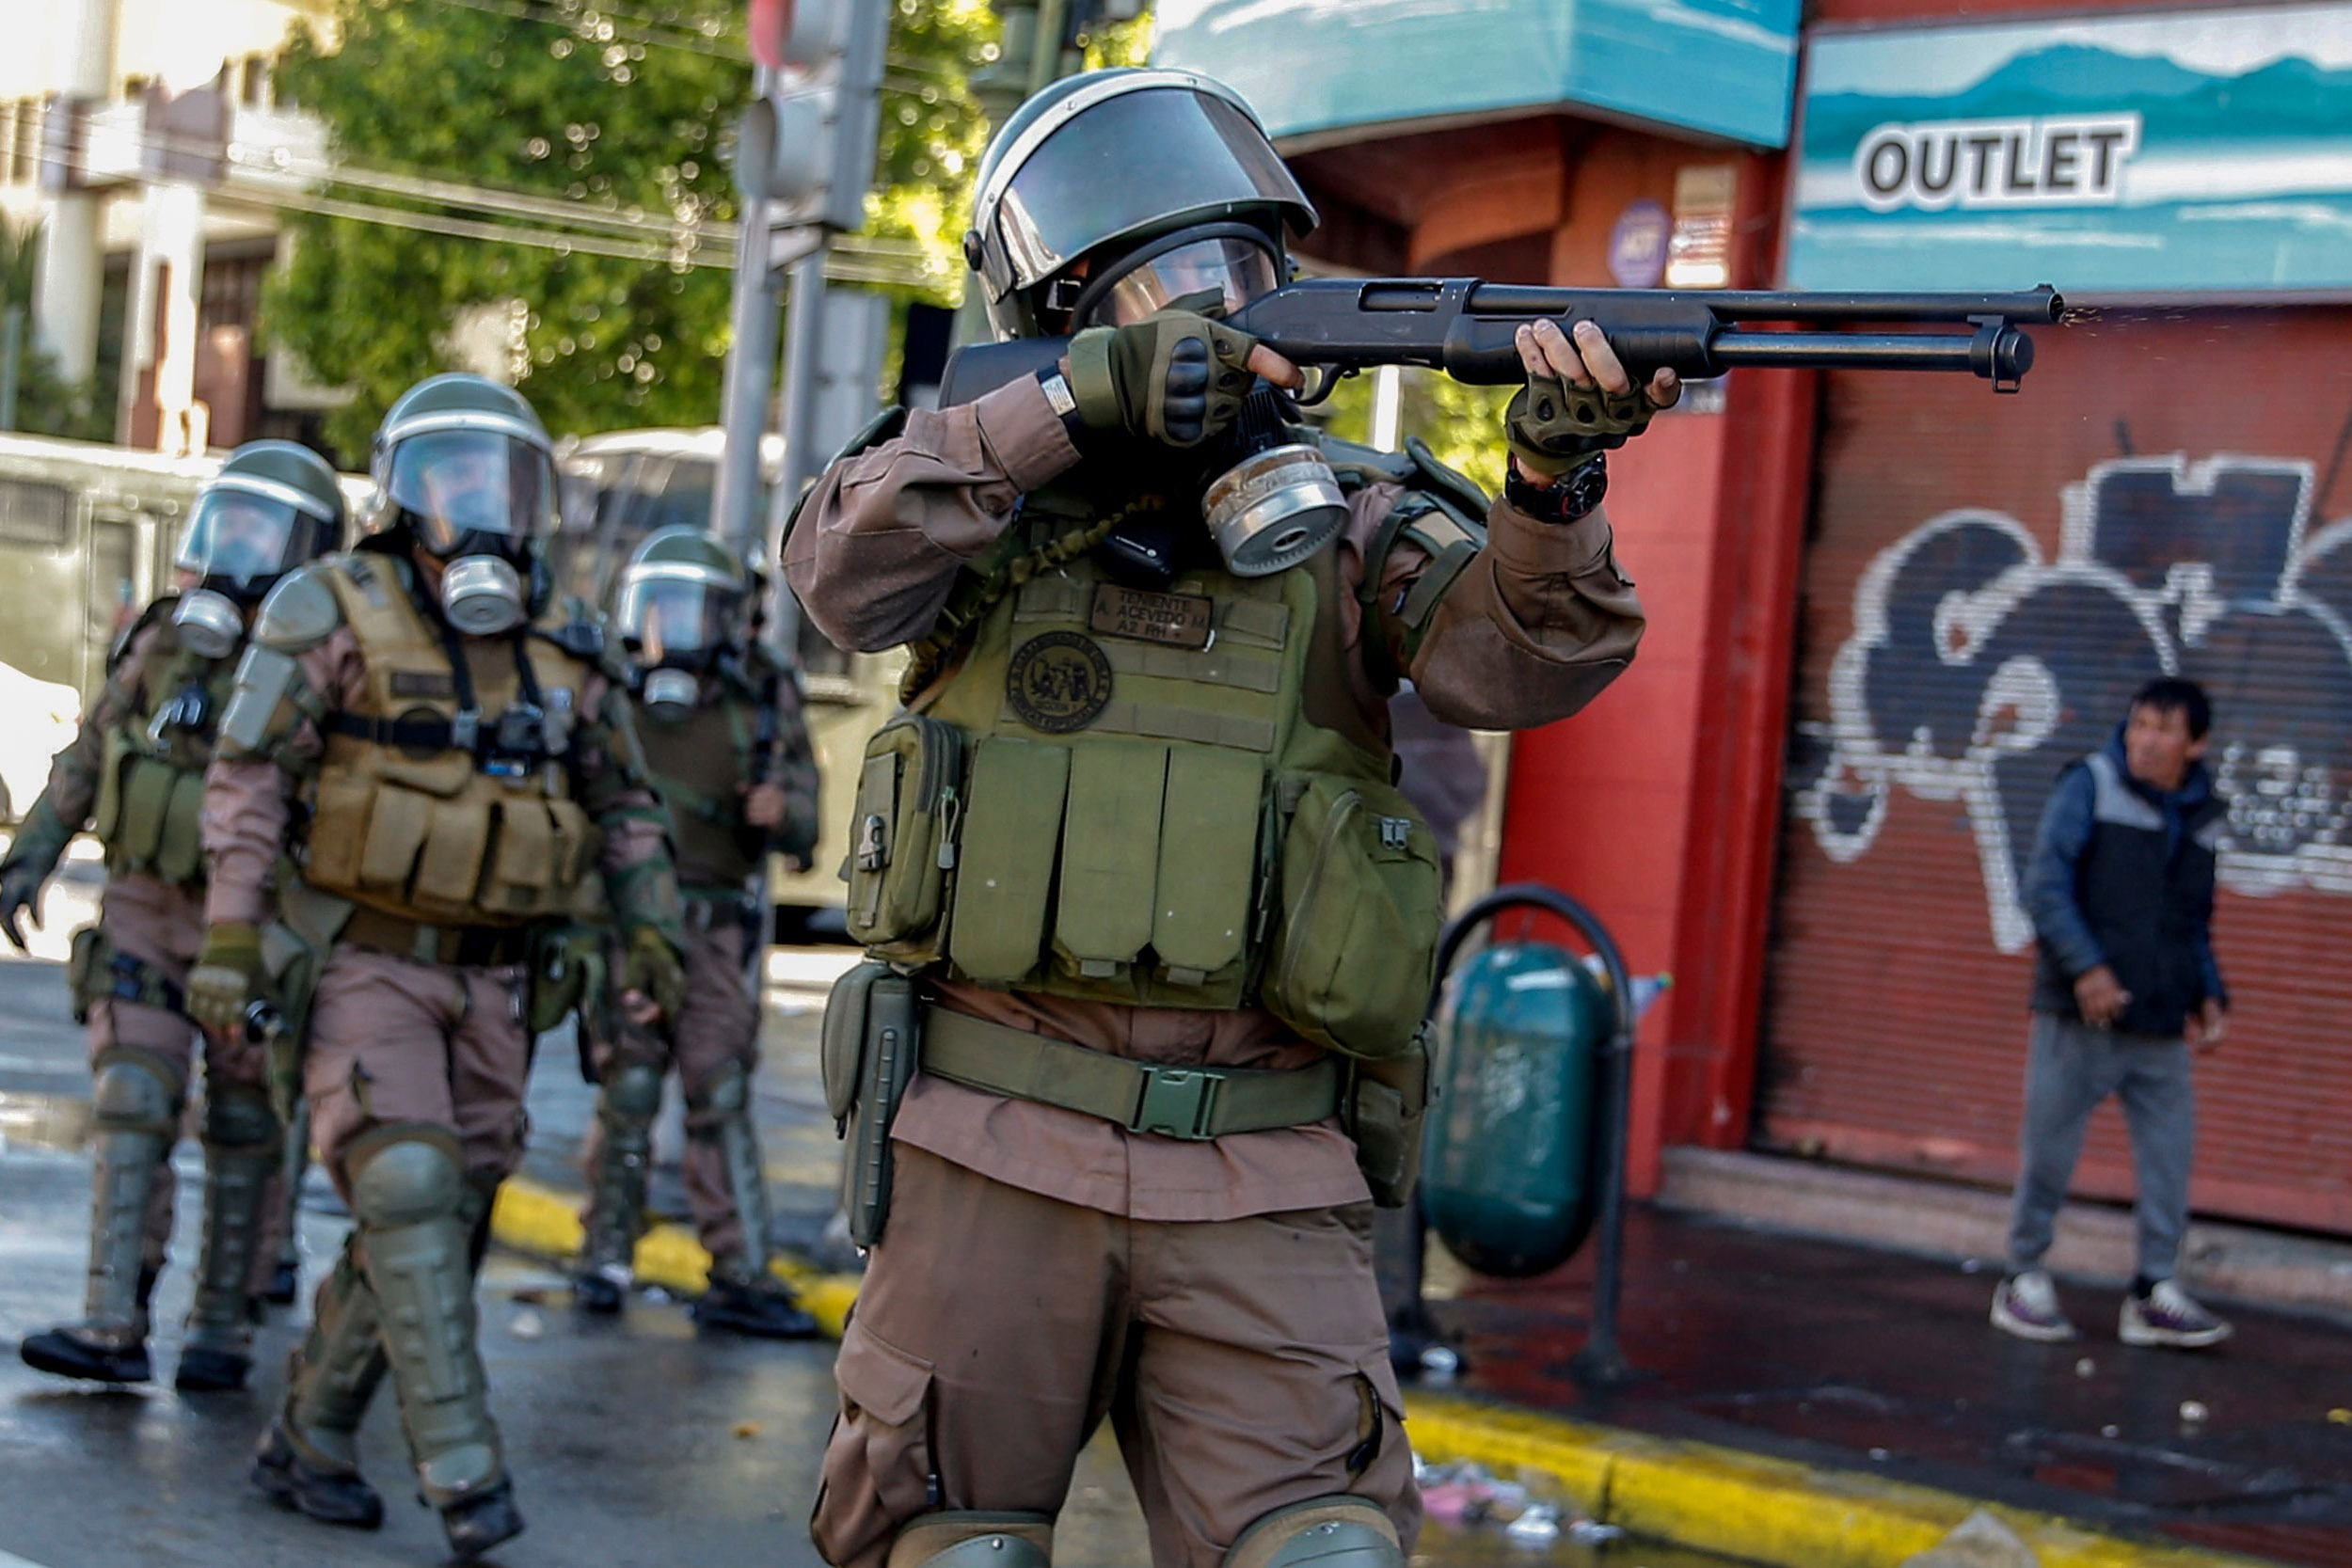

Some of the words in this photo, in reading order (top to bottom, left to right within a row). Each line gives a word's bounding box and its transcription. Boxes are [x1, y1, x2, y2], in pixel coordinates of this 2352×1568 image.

[1861, 123, 2130, 201] OUTLET
[1119, 591, 1191, 611] TENIENTE
[1116, 605, 1185, 626] ACEVEDO
